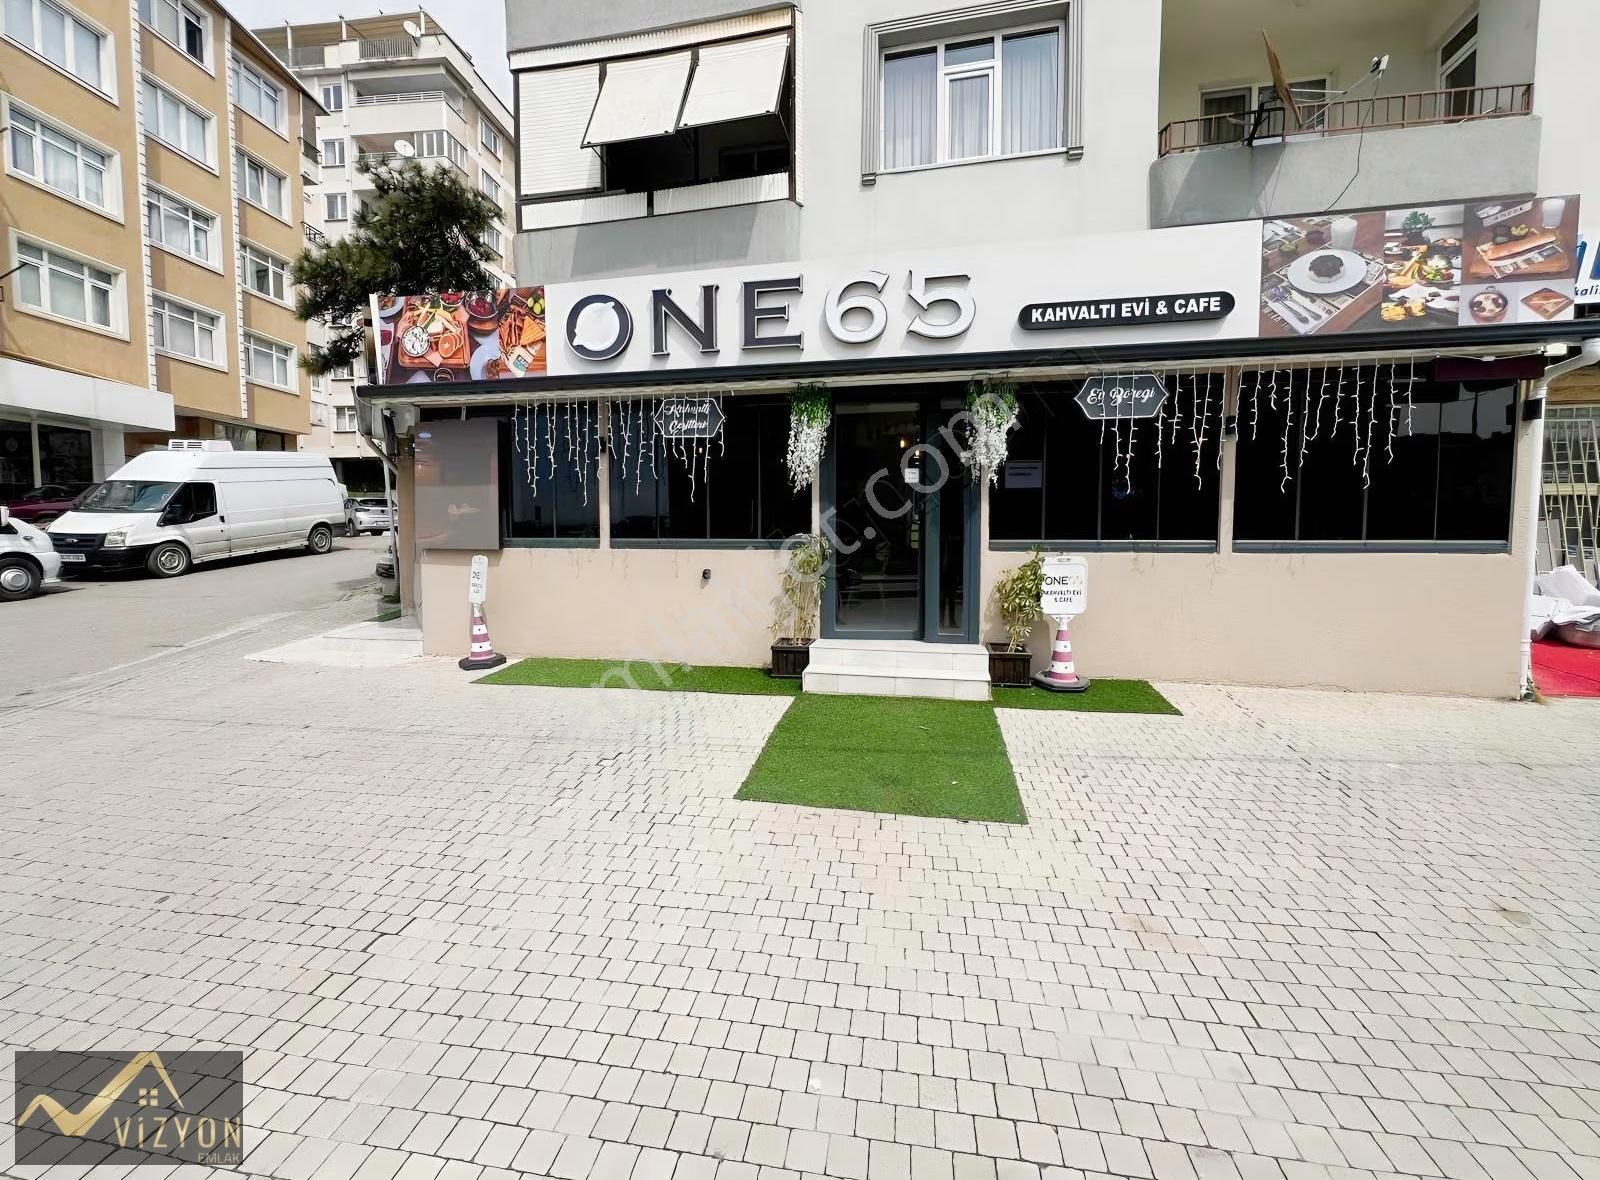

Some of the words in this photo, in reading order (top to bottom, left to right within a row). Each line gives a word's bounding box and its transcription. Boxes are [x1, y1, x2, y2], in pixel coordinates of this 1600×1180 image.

[565, 269, 977, 362] ONE65
[1031, 303, 1116, 323] KAHVALTI
[1121, 298, 1150, 317] EVİ
[1155, 300, 1168, 315] &
[1174, 296, 1221, 314] CAFE
